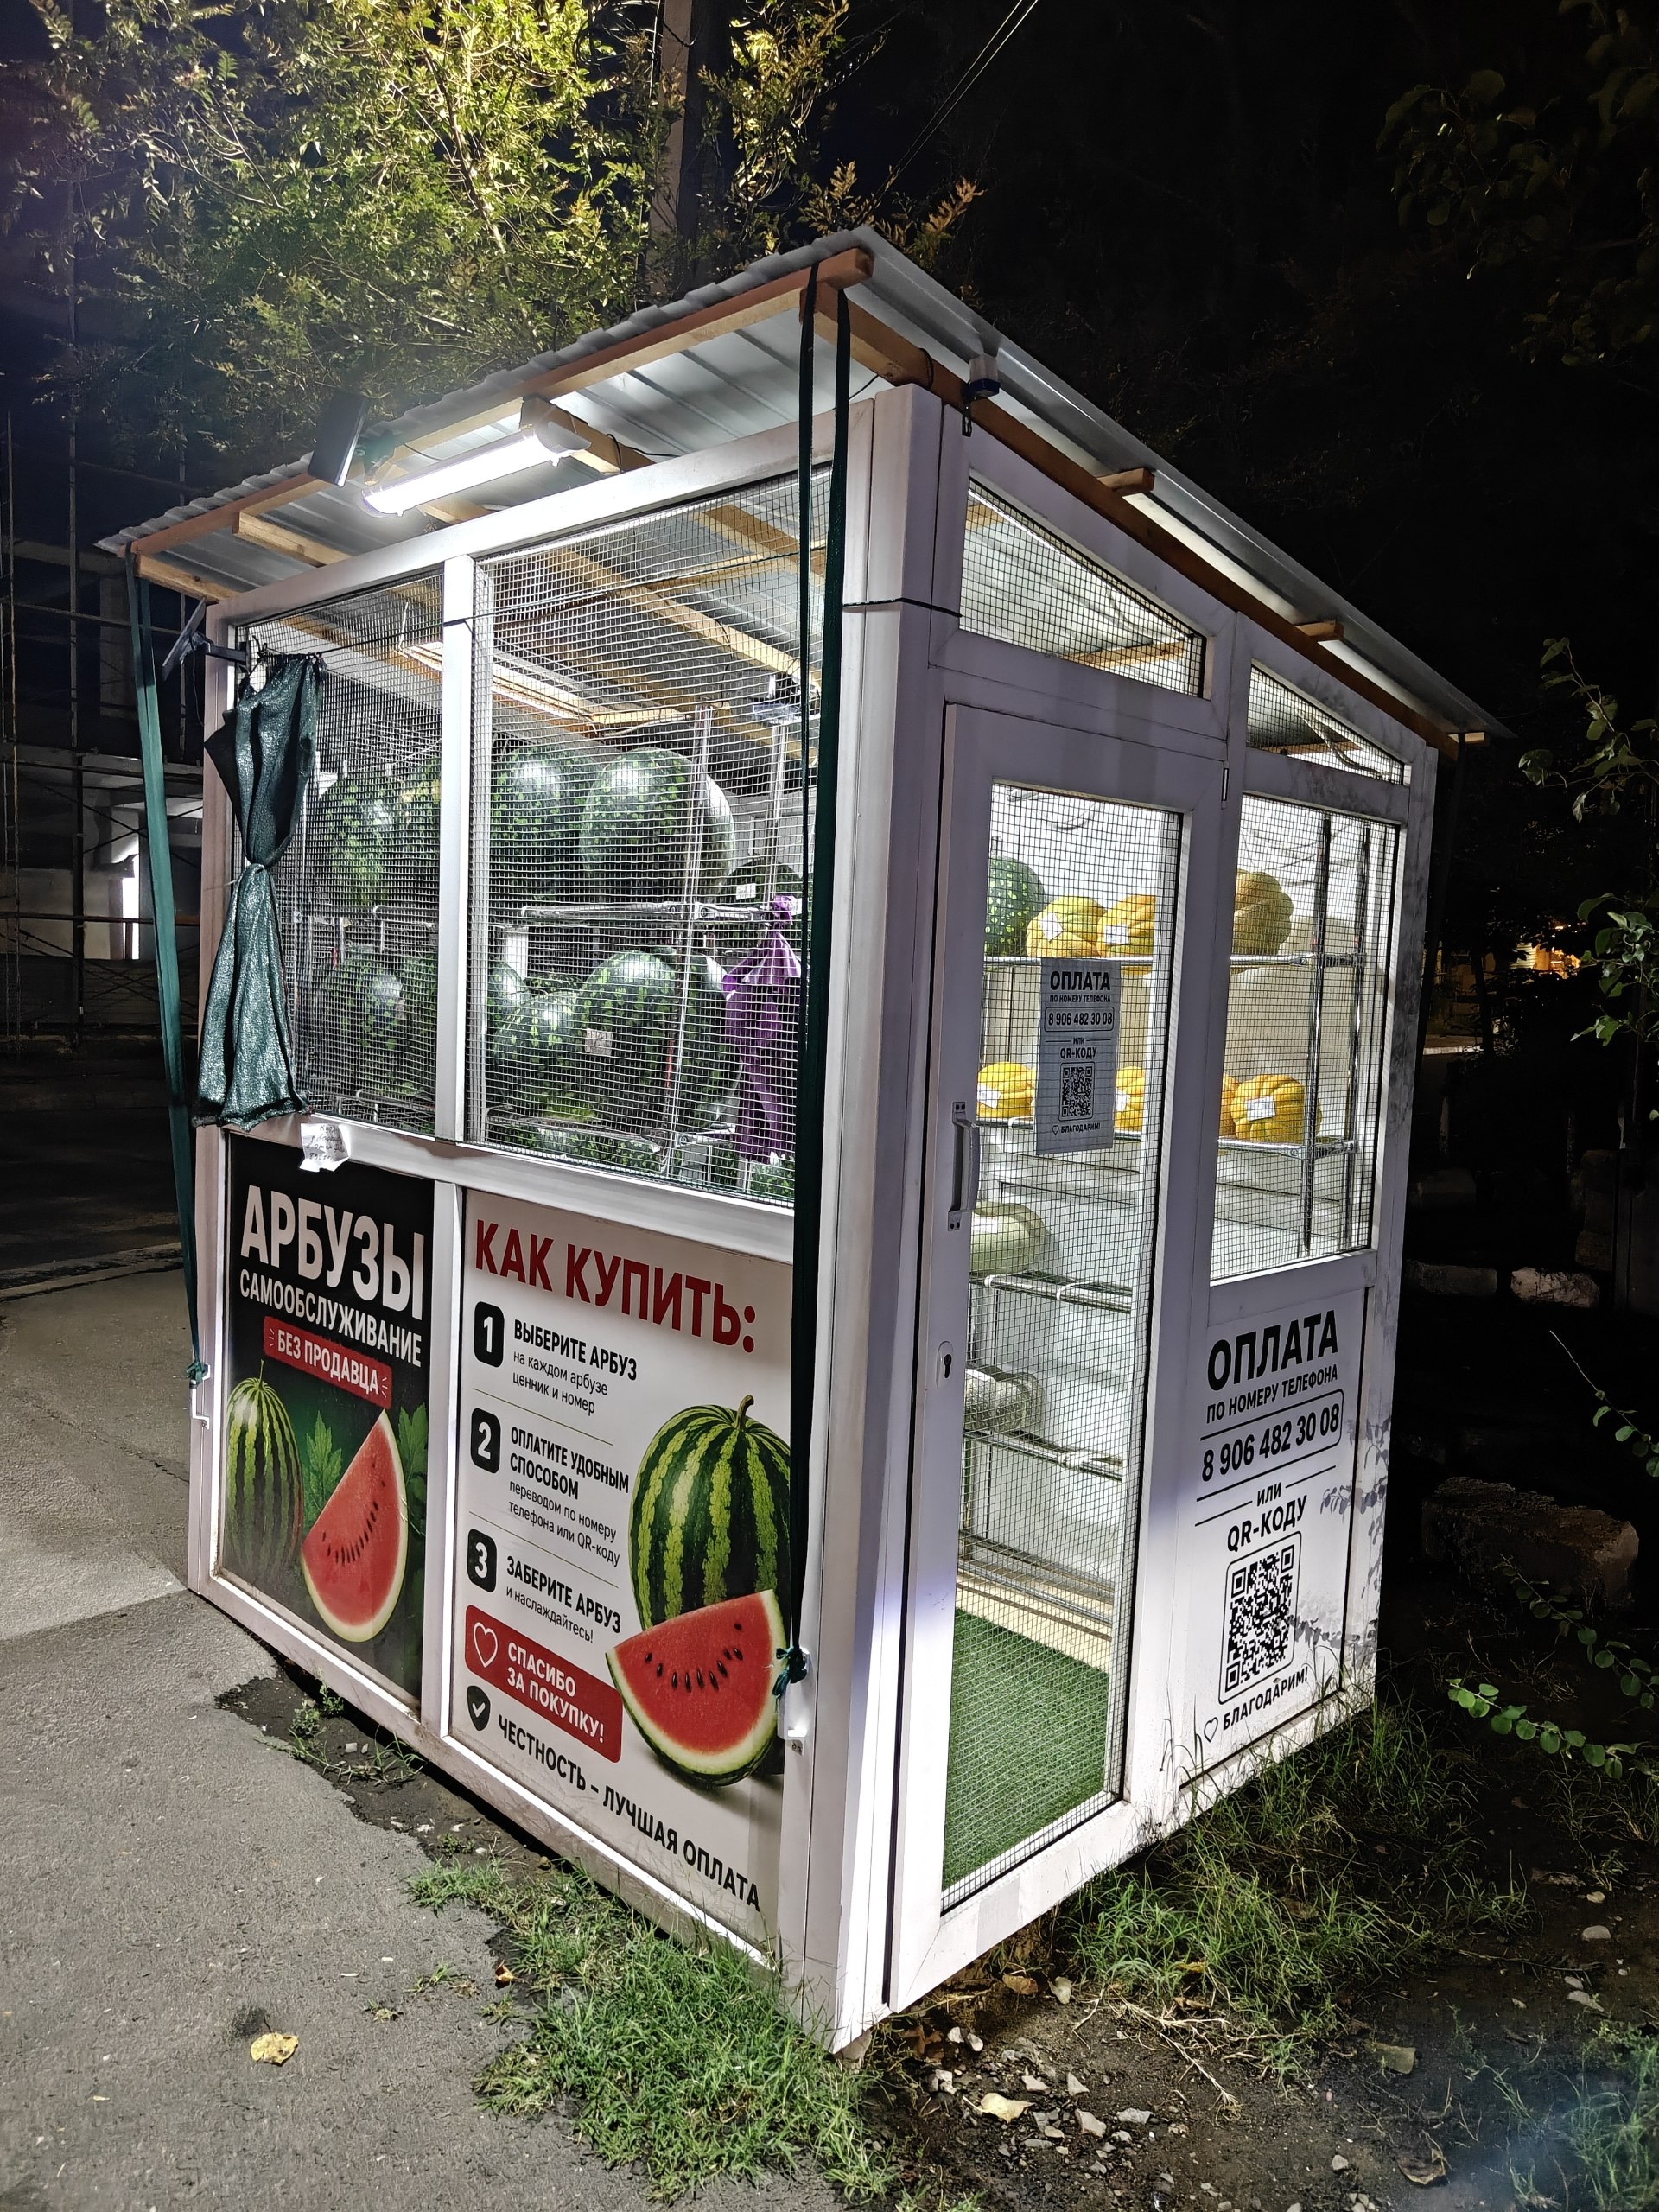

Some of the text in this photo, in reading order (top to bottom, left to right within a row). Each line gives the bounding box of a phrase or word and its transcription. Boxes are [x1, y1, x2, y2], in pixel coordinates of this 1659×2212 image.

[1050, 971, 1110, 991] ОПЛАТА
[1048, 1012, 1112, 1026] 8 906 482 30 08
[1060, 1046, 1097, 1059] QR-КОДУ
[241, 1185, 424, 1320] АРБУЗЫ
[475, 1218, 756, 1353] КАК КУПИТЬ:
[240, 1269, 422, 1368] САМООБСЛУЖИВАНИЕ
[483, 1316, 493, 1353] 1
[277, 1329, 379, 1395] БЕЗ ПРОДАВЦА
[513, 1351, 608, 1395] на каждом арбузе
[514, 1319, 637, 1381] ВЫБЕРИТЕ АРБУЗ
[1207, 1310, 1338, 1391] ОПЛАТА
[512, 1372, 595, 1416] ценник и номер
[1207, 1364, 1338, 1423] ПО НОМЕРУ ТЕЛЕФОНА
[478, 1421, 492, 1460] 2
[511, 1426, 629, 1493] ОПЛАТИТЕ УДОБНЫМ
[1202, 1403, 1339, 1481] 8 906 482 30 08
[510, 1452, 579, 1500] СПОСОБОМ
[1257, 1483, 1281, 1506] ИЛИ
[509, 1502, 620, 1567] телефона или QR-коду
[510, 1481, 616, 1543] переводом по номеру
[1228, 1495, 1307, 1552] QR-КОДУ
[474, 1542, 487, 1579] 3
[506, 1586, 594, 1643] и наслаждайтесь!
[507, 1556, 621, 1633] ЗАБЕРИТЕ АРБУЗ
[508, 1643, 576, 1698] СПАСИБО
[1223, 1667, 1308, 1731] БЛАГОДАРИМ!
[507, 1667, 604, 1743] ЗА ПОКУПКУ!
[499, 1715, 586, 1787] ЧЕСТНОСТЬ
[603, 1785, 677, 1854] ЛУЧШАЯ
[683, 1840, 760, 1911] ОПЛАТА
